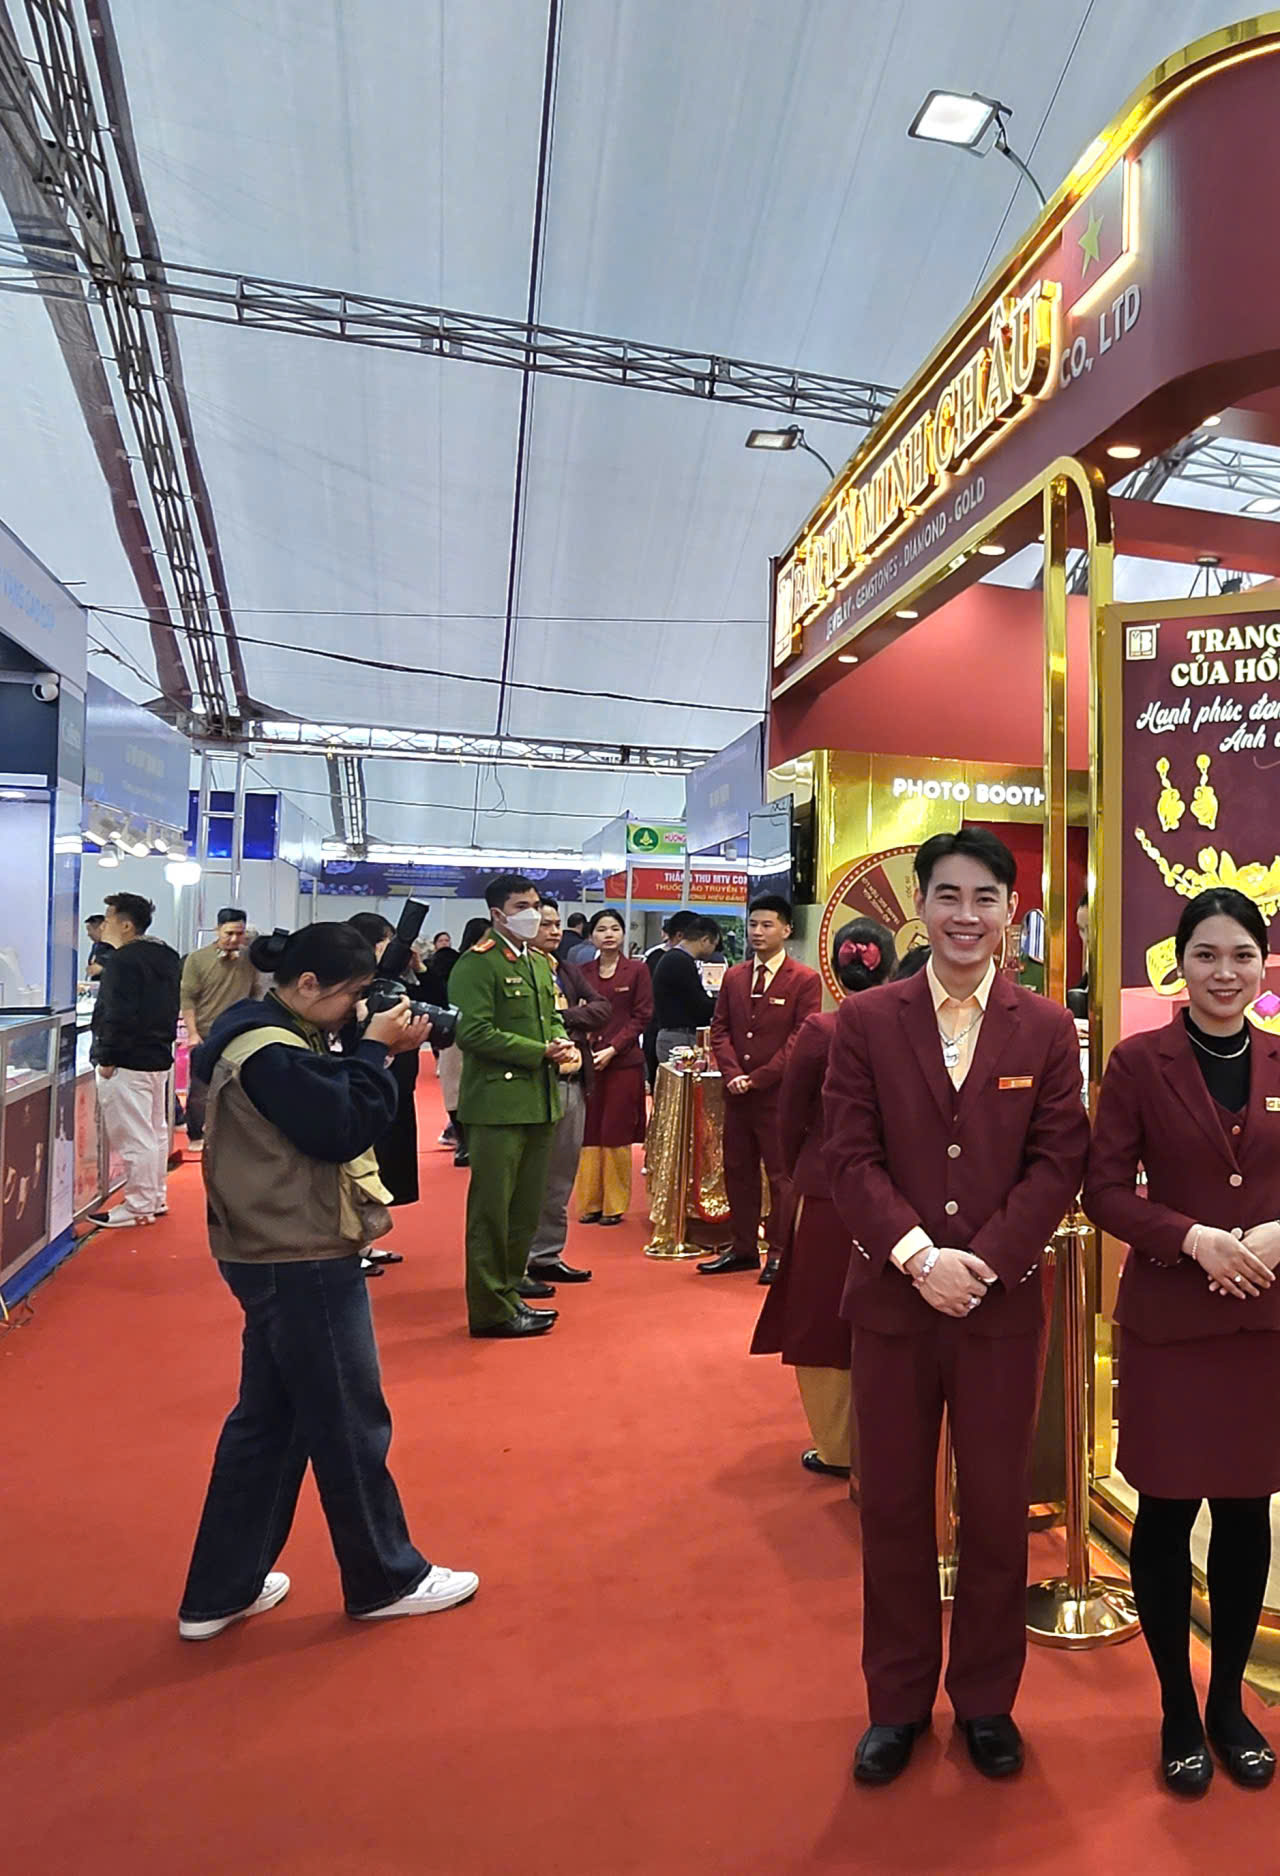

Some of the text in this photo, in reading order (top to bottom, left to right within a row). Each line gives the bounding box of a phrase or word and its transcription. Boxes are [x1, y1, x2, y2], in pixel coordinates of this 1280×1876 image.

[1098, 284, 1142, 356] LTD
[933, 280, 1058, 474] CHÂU
[903, 512, 947, 567] DIAMOND
[954, 477, 985, 521] GOLD
[1170, 653, 1229, 688] CỦA
[1136, 698, 1191, 735] Hạnh
[1194, 695, 1243, 733] phúc
[1219, 722, 1266, 755] Ánh
[893, 777, 970, 802] PHOTO
[695, 873, 711, 883] THU
